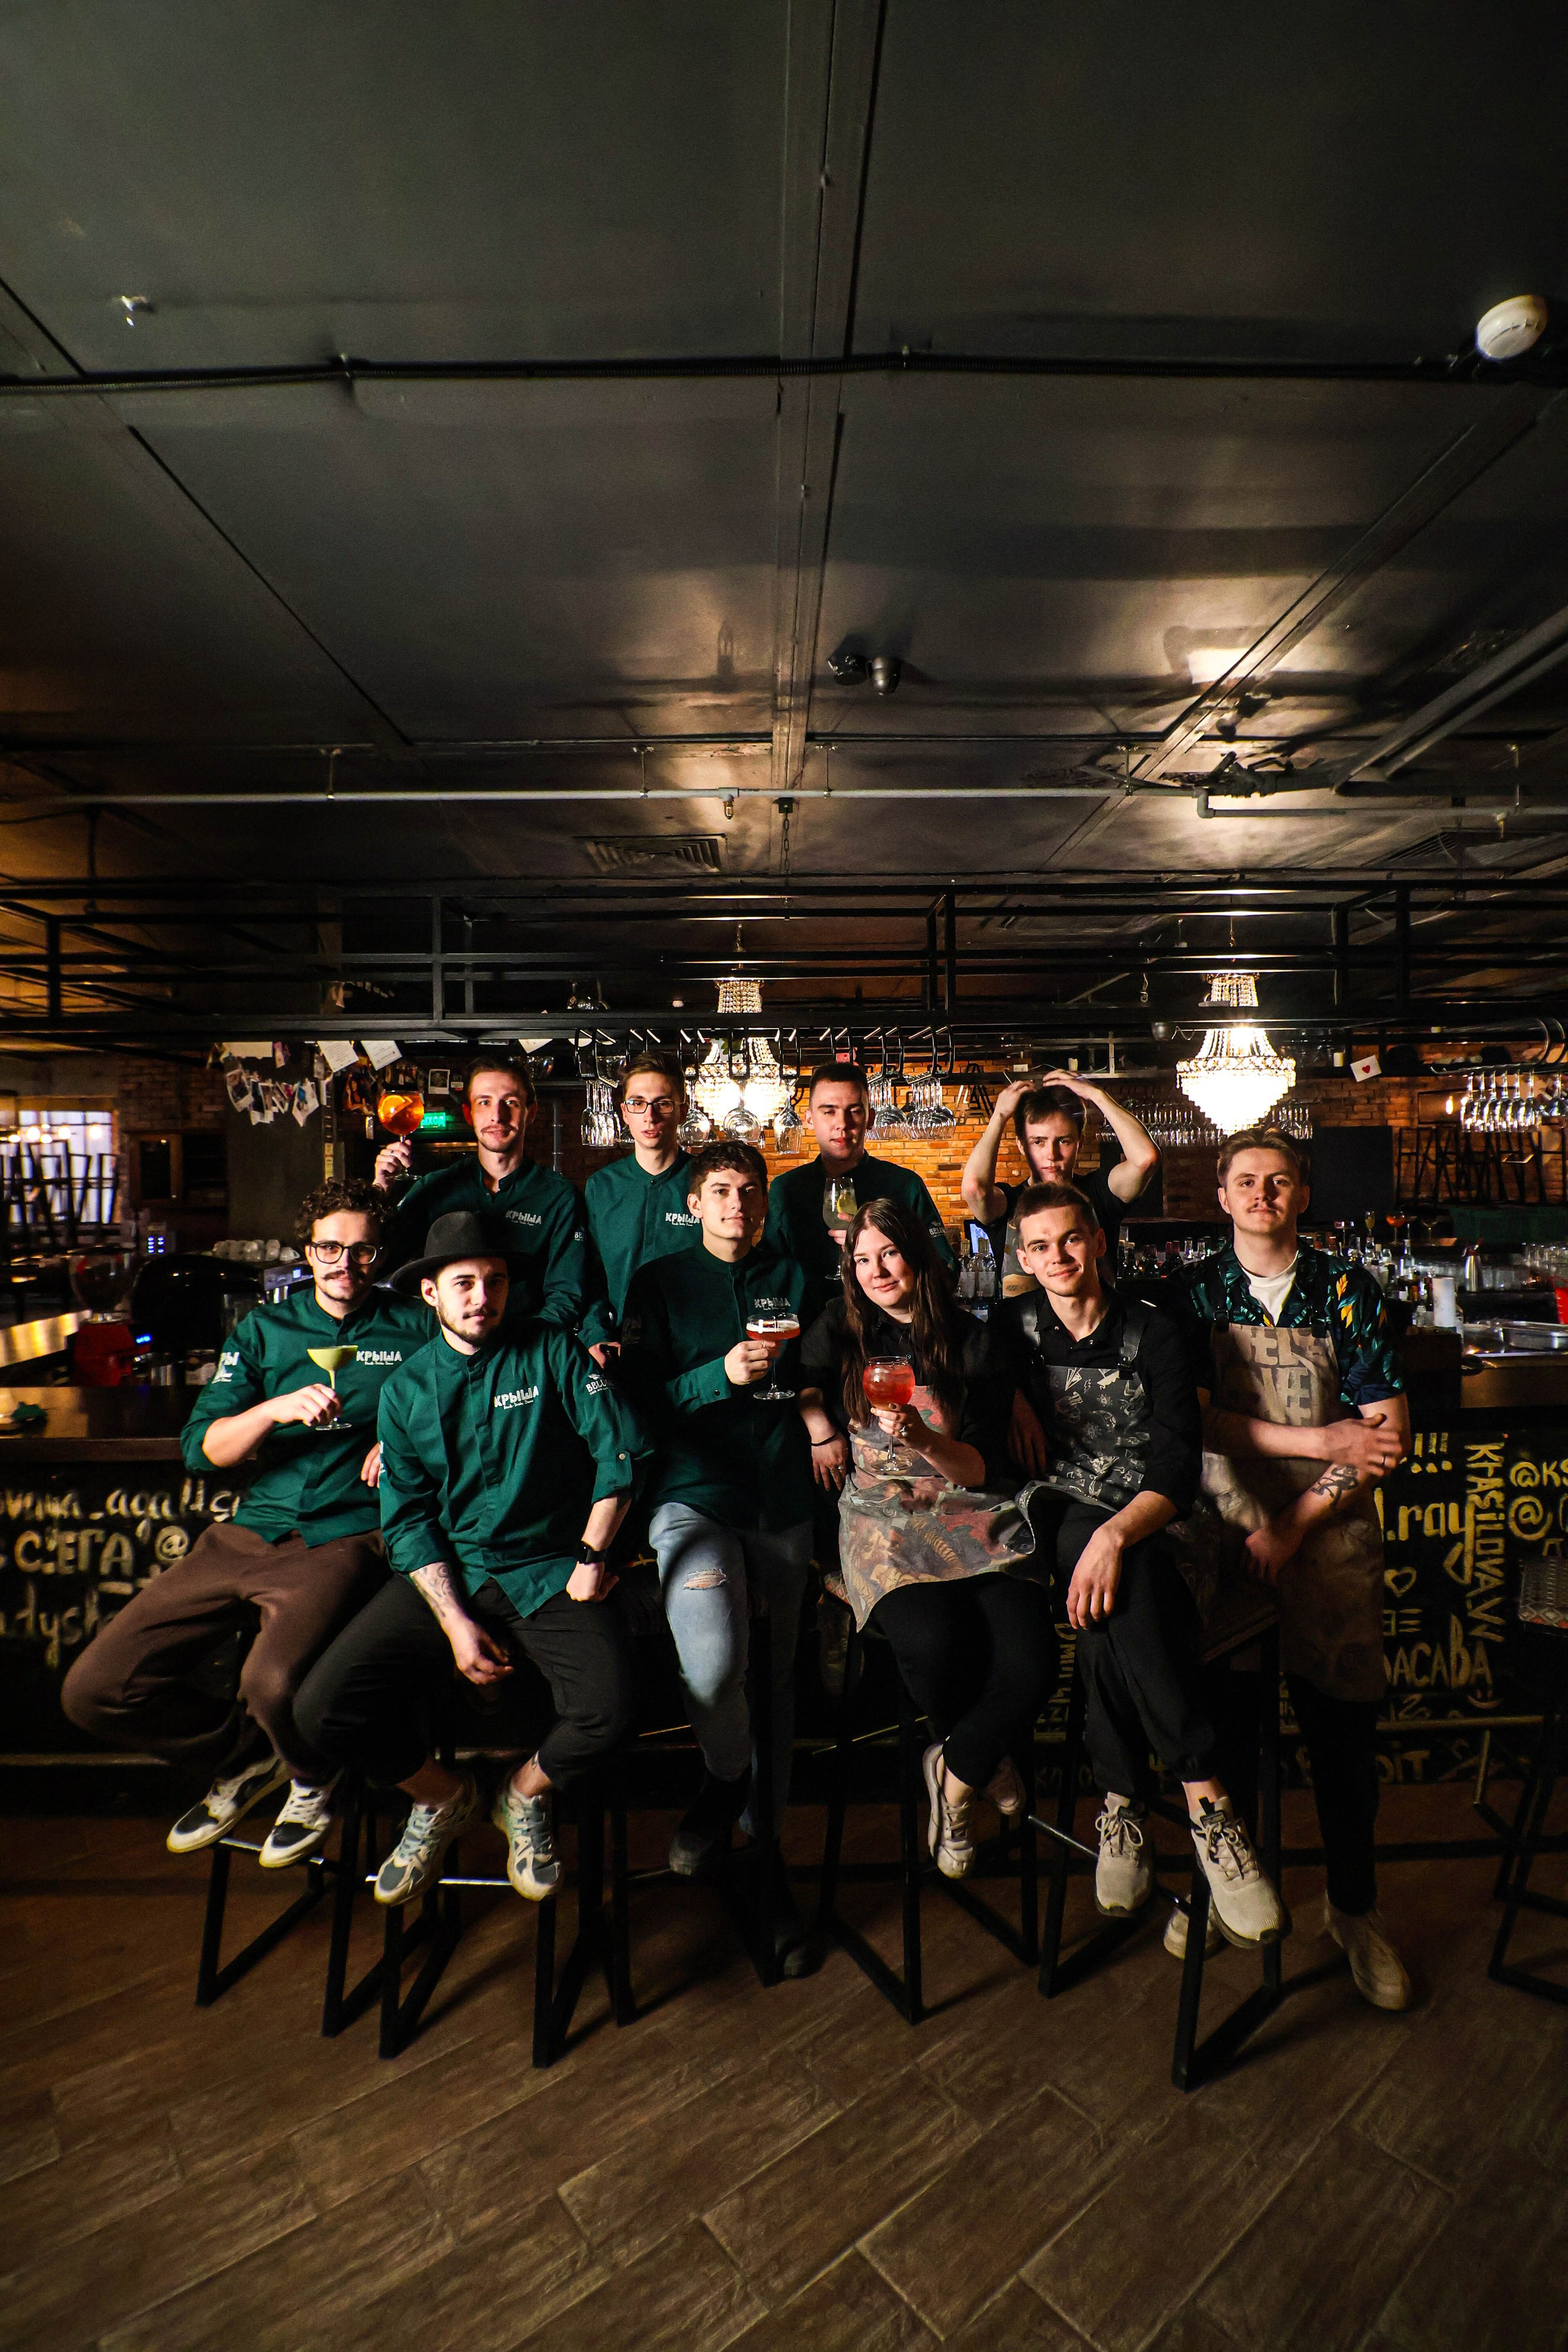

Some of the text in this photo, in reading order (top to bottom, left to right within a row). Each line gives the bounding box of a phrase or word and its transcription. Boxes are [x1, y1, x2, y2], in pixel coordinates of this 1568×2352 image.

[421, 1115, 445, 1127] ЫХОД
[505, 1210, 542, 1225] КРЫША
[665, 1212, 700, 1224] КРЫША
[754, 1297, 791, 1308] КРЫША
[356, 1351, 402, 1362] КРЫША
[494, 1385, 539, 1408] КРЫША
